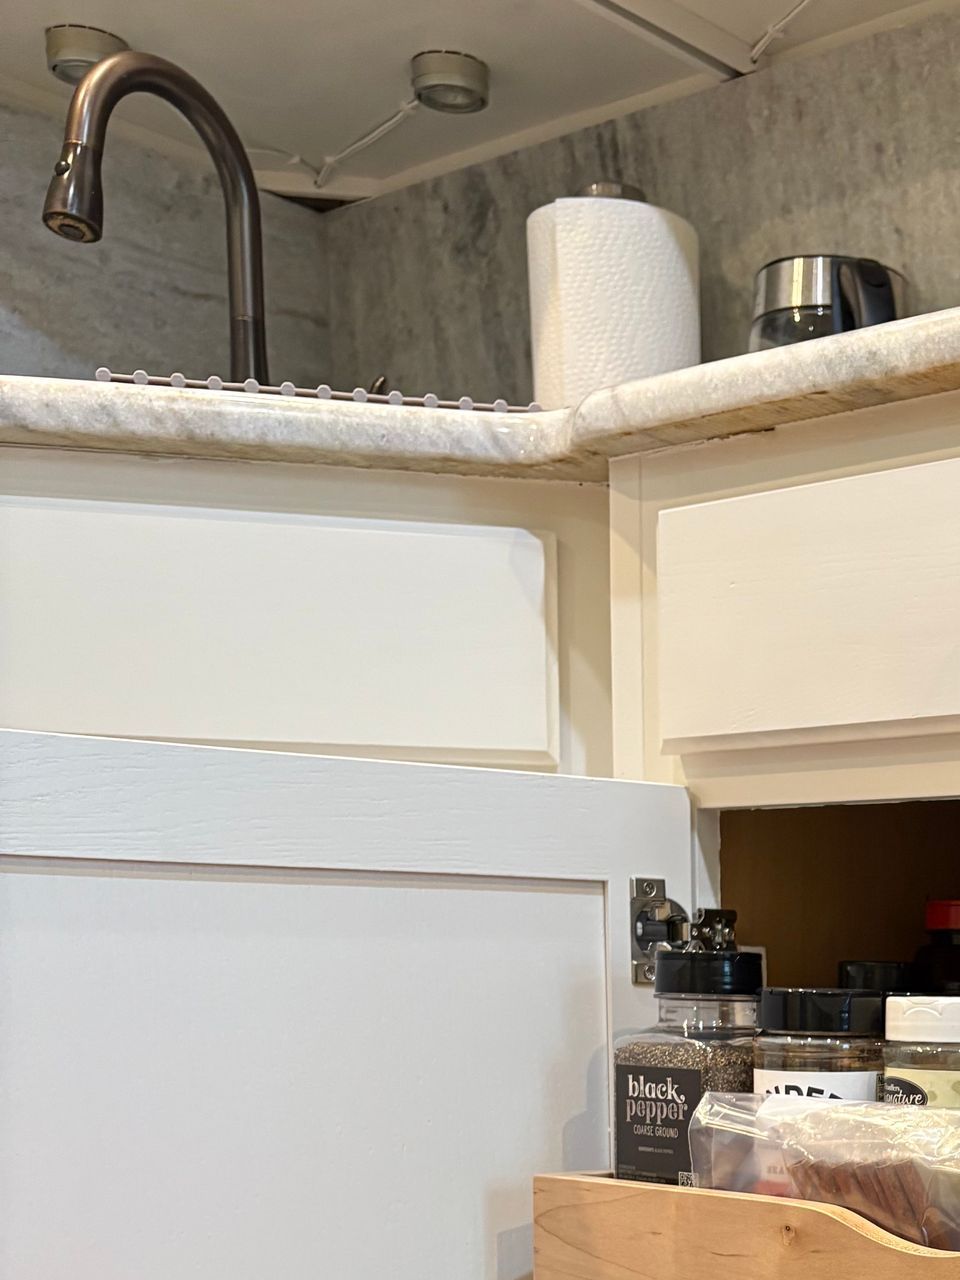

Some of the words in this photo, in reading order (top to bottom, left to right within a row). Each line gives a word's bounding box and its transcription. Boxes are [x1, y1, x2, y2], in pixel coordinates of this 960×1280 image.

[628, 1074, 686, 1104] black
[626, 1099, 688, 1125] pepper
[633, 1124, 654, 1137] COARSE
[655, 1125, 679, 1139] GROUND
